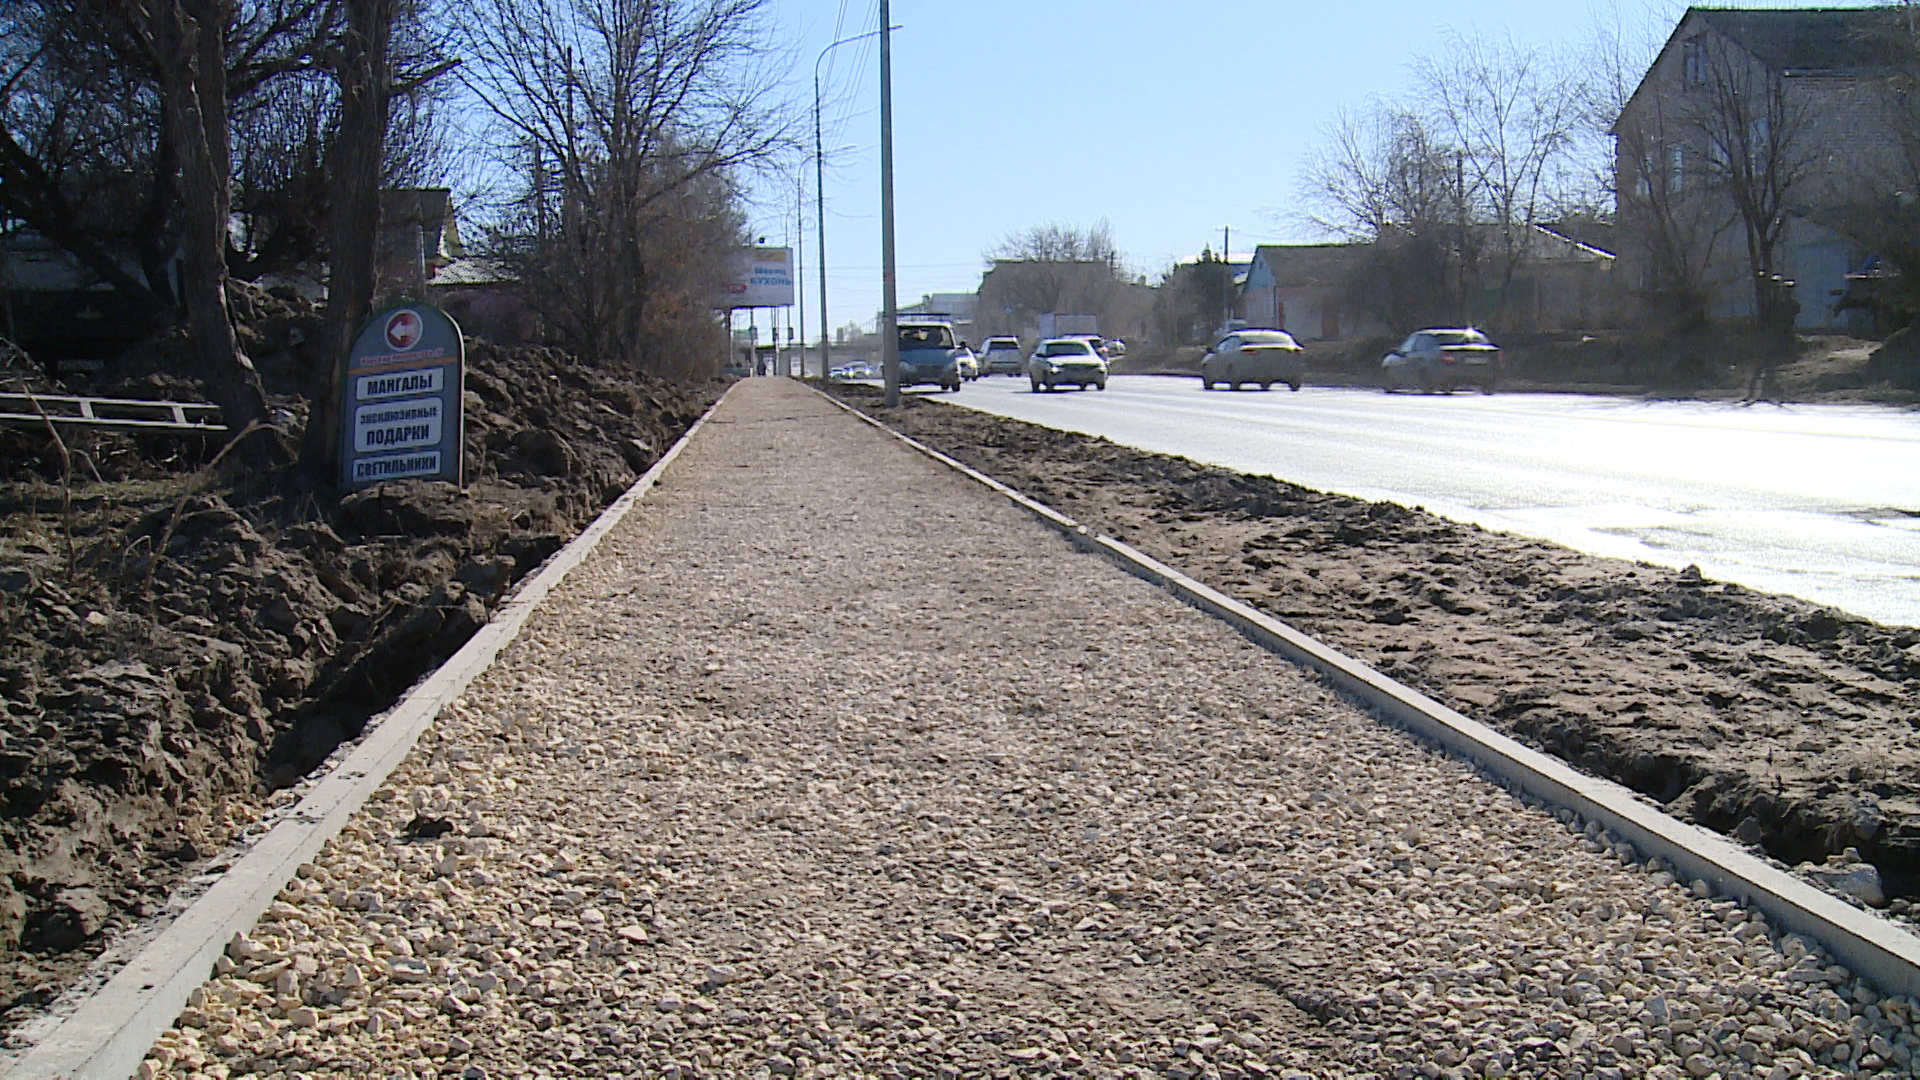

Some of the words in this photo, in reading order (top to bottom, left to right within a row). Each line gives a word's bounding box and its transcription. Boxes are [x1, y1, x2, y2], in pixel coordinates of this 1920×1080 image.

[367, 373, 433, 396] МАНГАЛЫ
[366, 424, 430, 446] ПОДАРКИ
[357, 456, 437, 478] СВЕТИЛЬНИКИ
